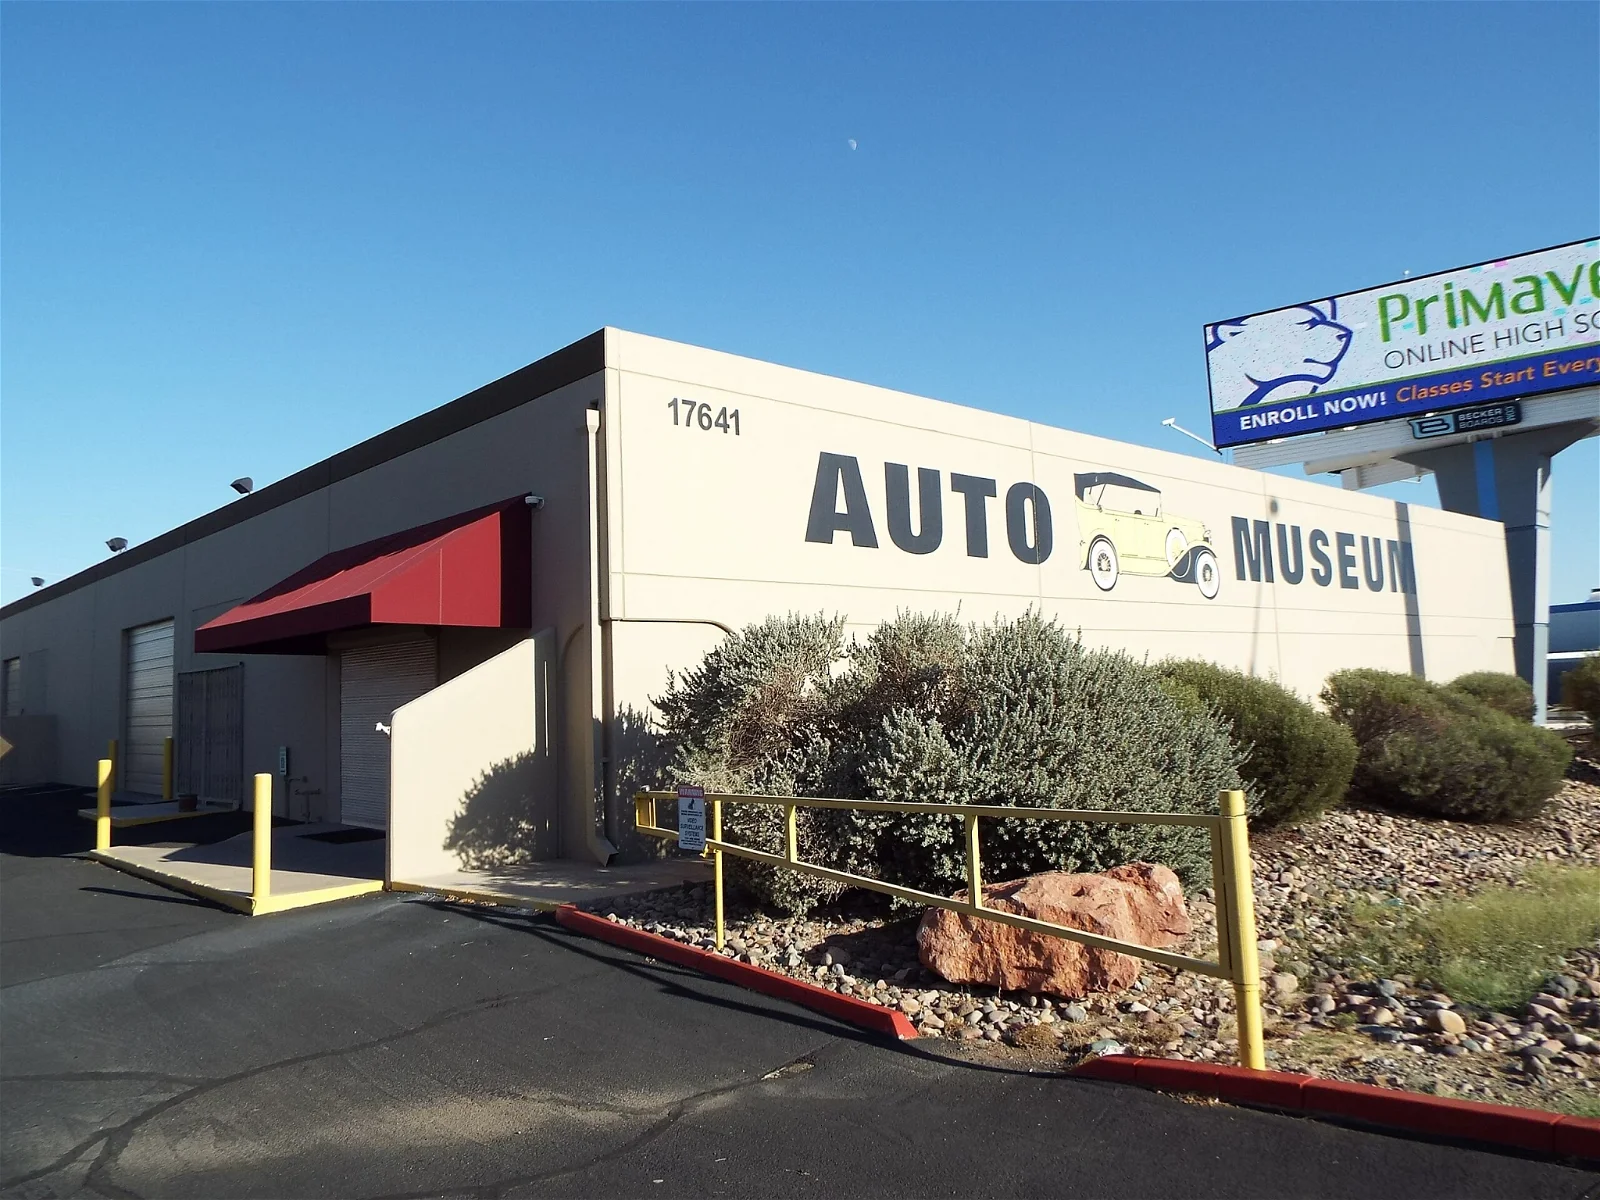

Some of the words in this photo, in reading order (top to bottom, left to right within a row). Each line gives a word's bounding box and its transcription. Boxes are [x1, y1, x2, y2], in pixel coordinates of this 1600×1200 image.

[1384, 333, 1485, 369] ONLINE
[1494, 318, 1564, 349] HIGH
[667, 397, 740, 436] 17641
[1240, 404, 1318, 430] ENROLL
[1323, 391, 1387, 416] NOW!
[1395, 378, 1474, 403] Classes
[1480, 365, 1536, 389] Start
[1458, 408, 1502, 421] BECKER
[1459, 415, 1504, 429] BOARDS
[805, 451, 1053, 565] AUTO
[1230, 515, 1417, 595] MUSEUM
